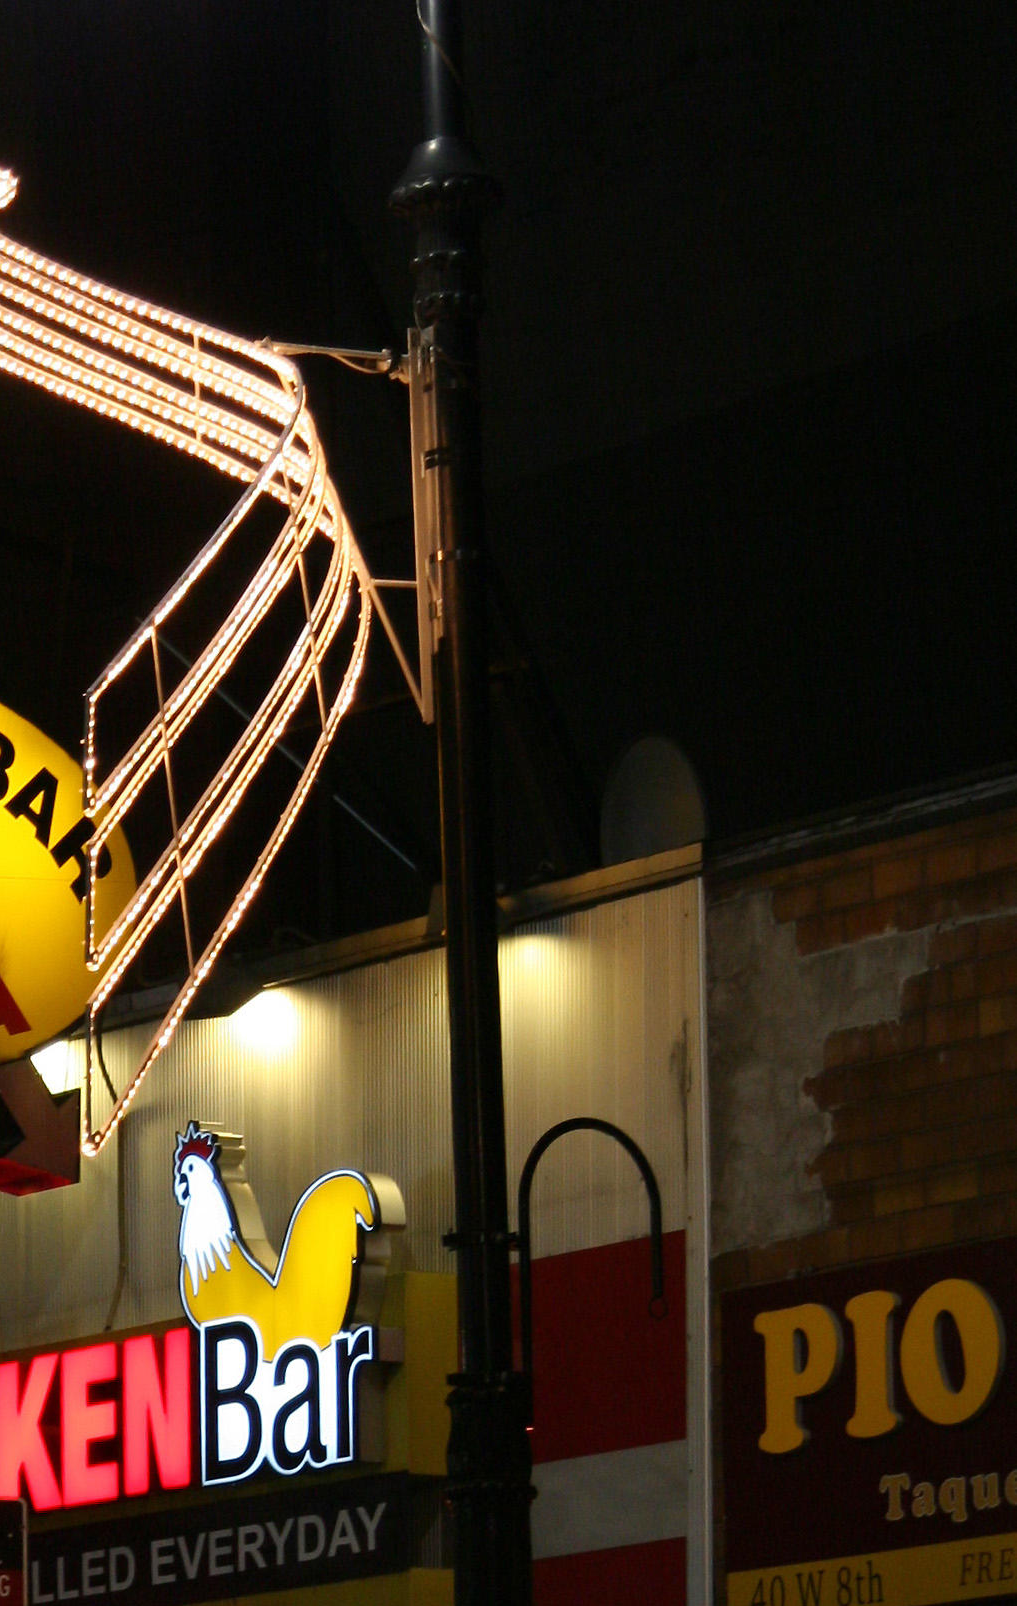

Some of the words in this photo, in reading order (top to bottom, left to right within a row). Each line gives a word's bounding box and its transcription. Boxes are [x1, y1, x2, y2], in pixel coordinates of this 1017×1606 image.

[202, 1321, 372, 1486] Bar
[753, 1278, 1005, 1453] PIO
[30, 1547, 135, 1603] LLED
[149, 1502, 387, 1587] EVERYDAY
[837, 1561, 883, 1606] 8th
